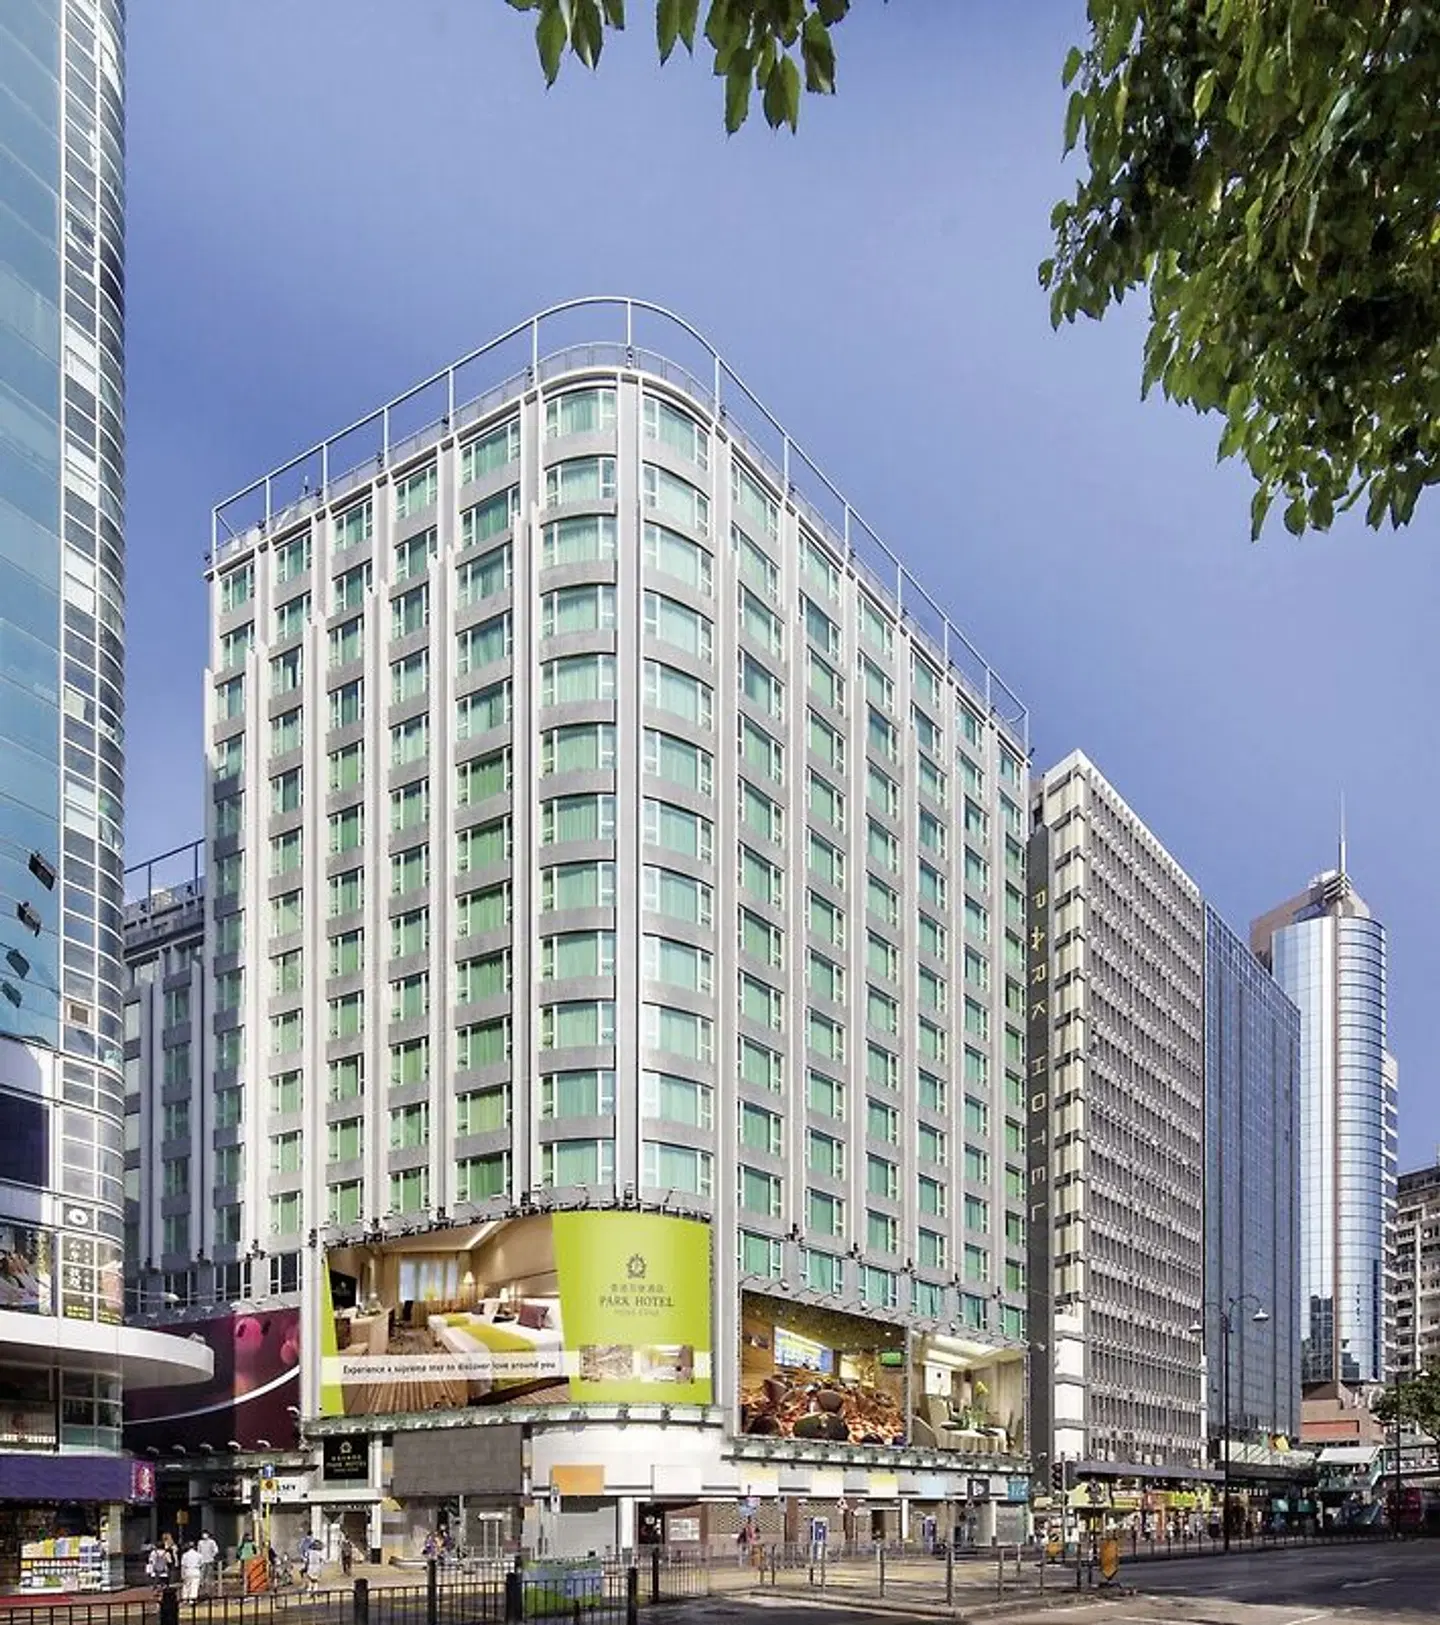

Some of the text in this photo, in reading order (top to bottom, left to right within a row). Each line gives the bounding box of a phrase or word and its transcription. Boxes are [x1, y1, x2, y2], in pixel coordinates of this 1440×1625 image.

[1031, 890, 1047, 1222] PARK HOTEL
[600, 1296, 675, 1307] PARK HOTEL
[343, 1365, 385, 1375] Experience
[394, 1365, 426, 1375] supreme
[457, 1362, 490, 1371] discover
[492, 1361, 509, 1370] love
[511, 1361, 538, 1370] around
[540, 1361, 555, 1370] you
